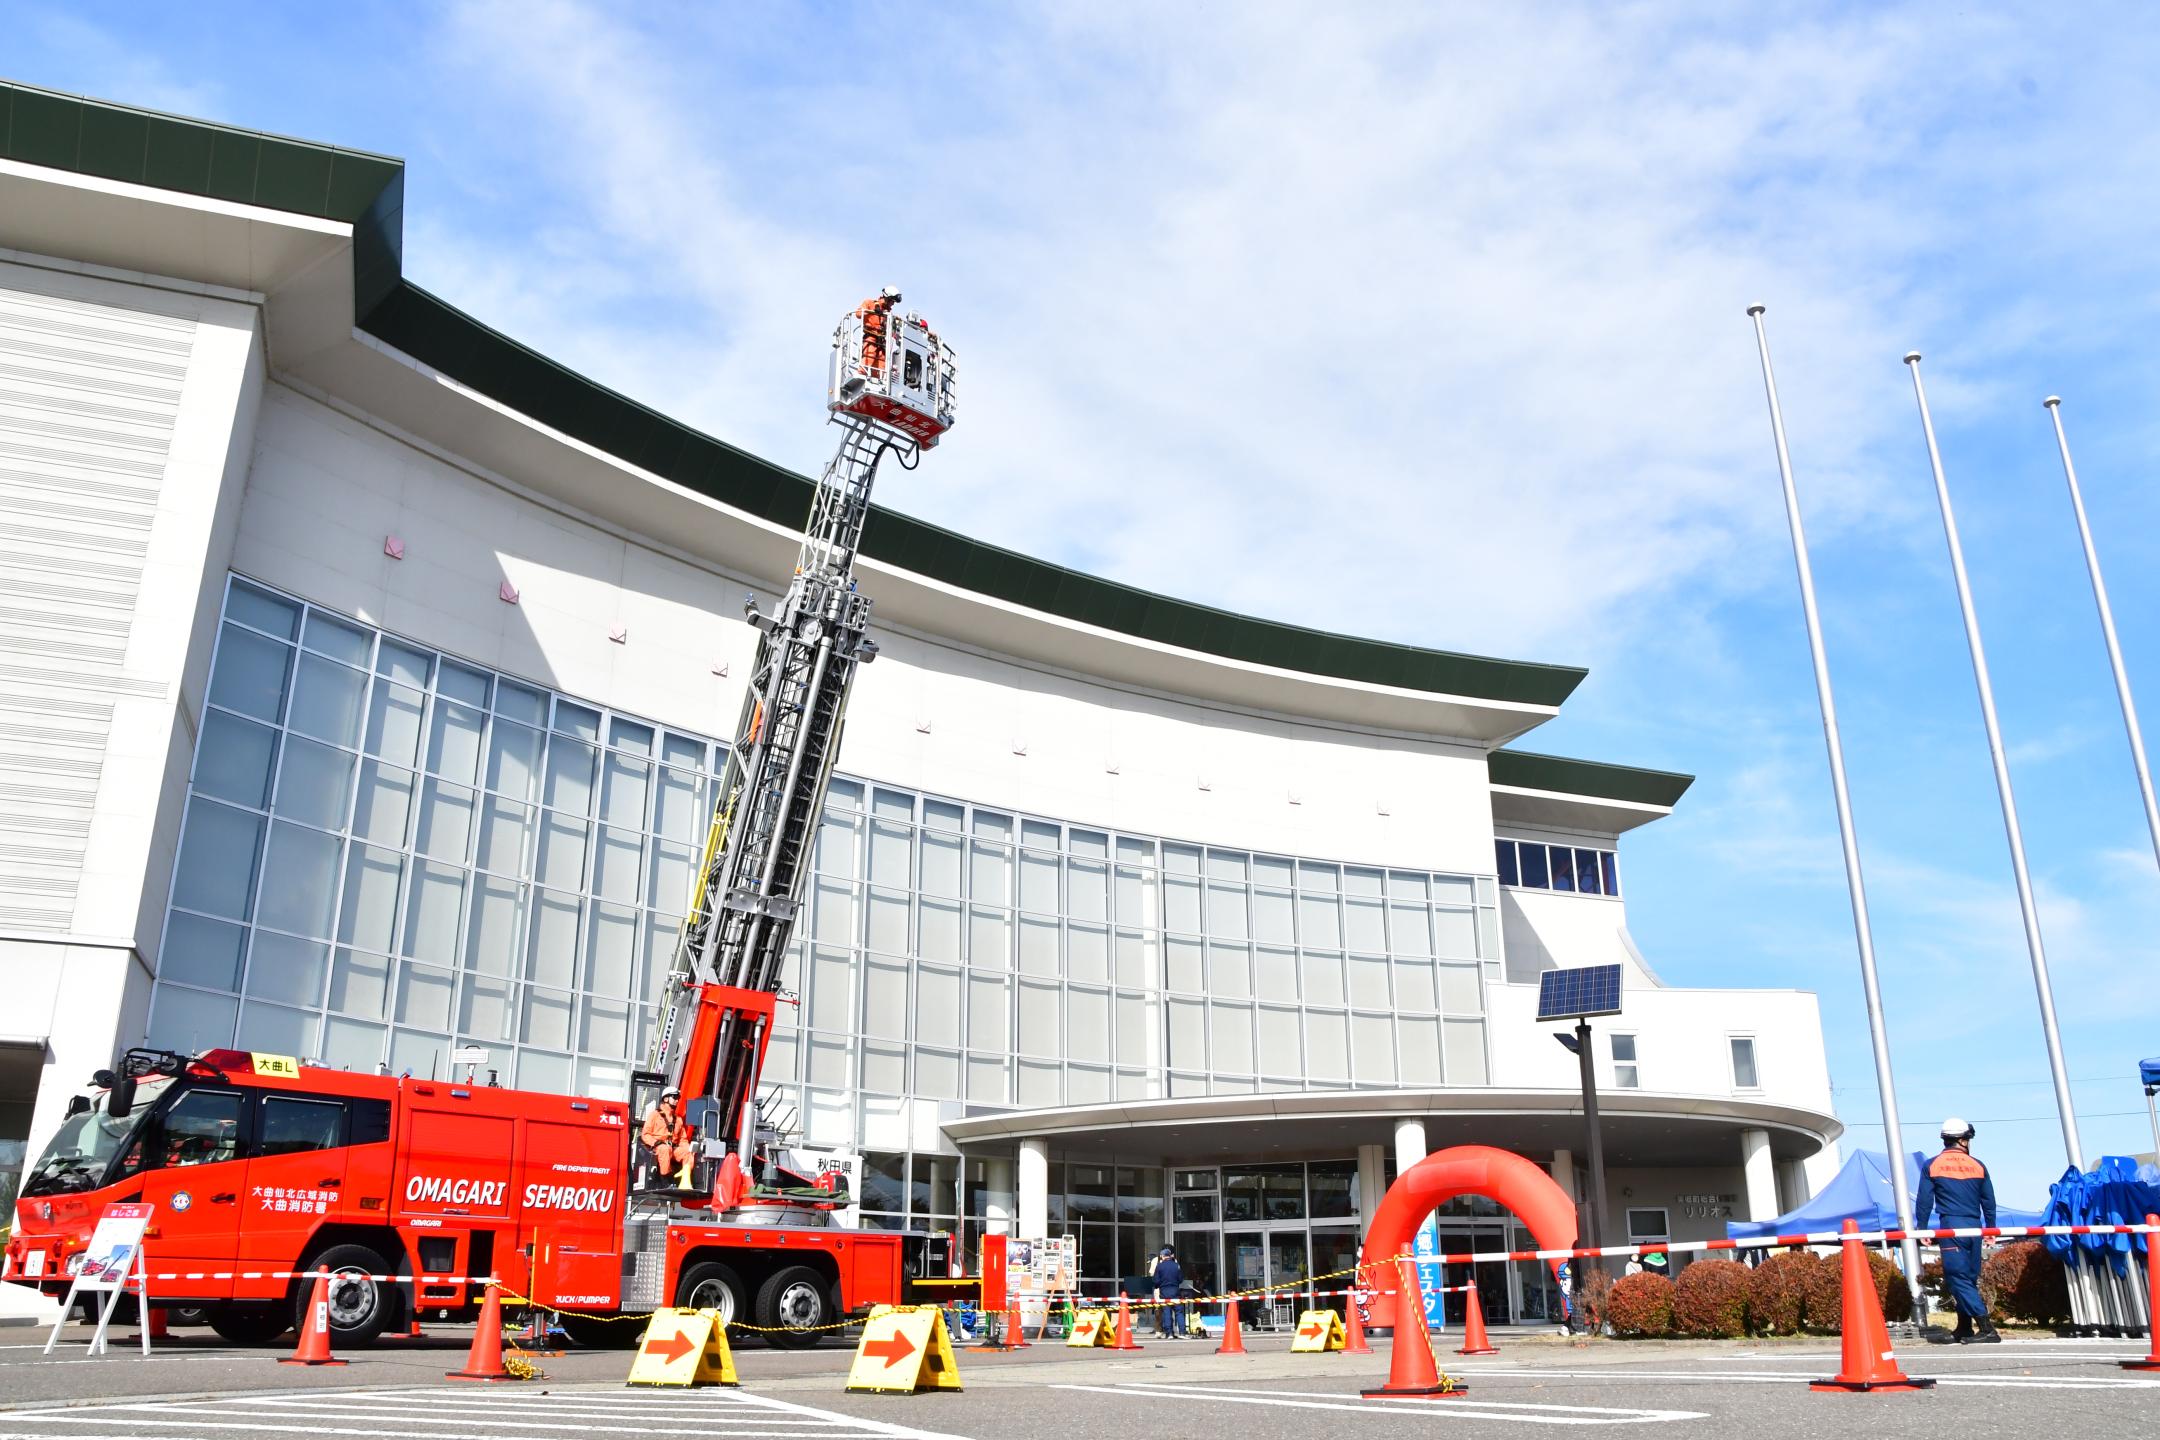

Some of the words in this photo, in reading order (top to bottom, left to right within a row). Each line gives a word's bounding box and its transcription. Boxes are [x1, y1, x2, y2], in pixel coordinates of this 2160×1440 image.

[259, 1059, 293, 1073] 大曲L
[567, 1165, 611, 1175] DEPARTMENT
[818, 1158, 852, 1175] 秋田県
[406, 1176, 507, 1206] OMAGARI
[522, 1184, 614, 1212] SEMBOKU
[261, 1198, 327, 1215] 大曲消防署
[1685, 1205, 1733, 1218] リリオス
